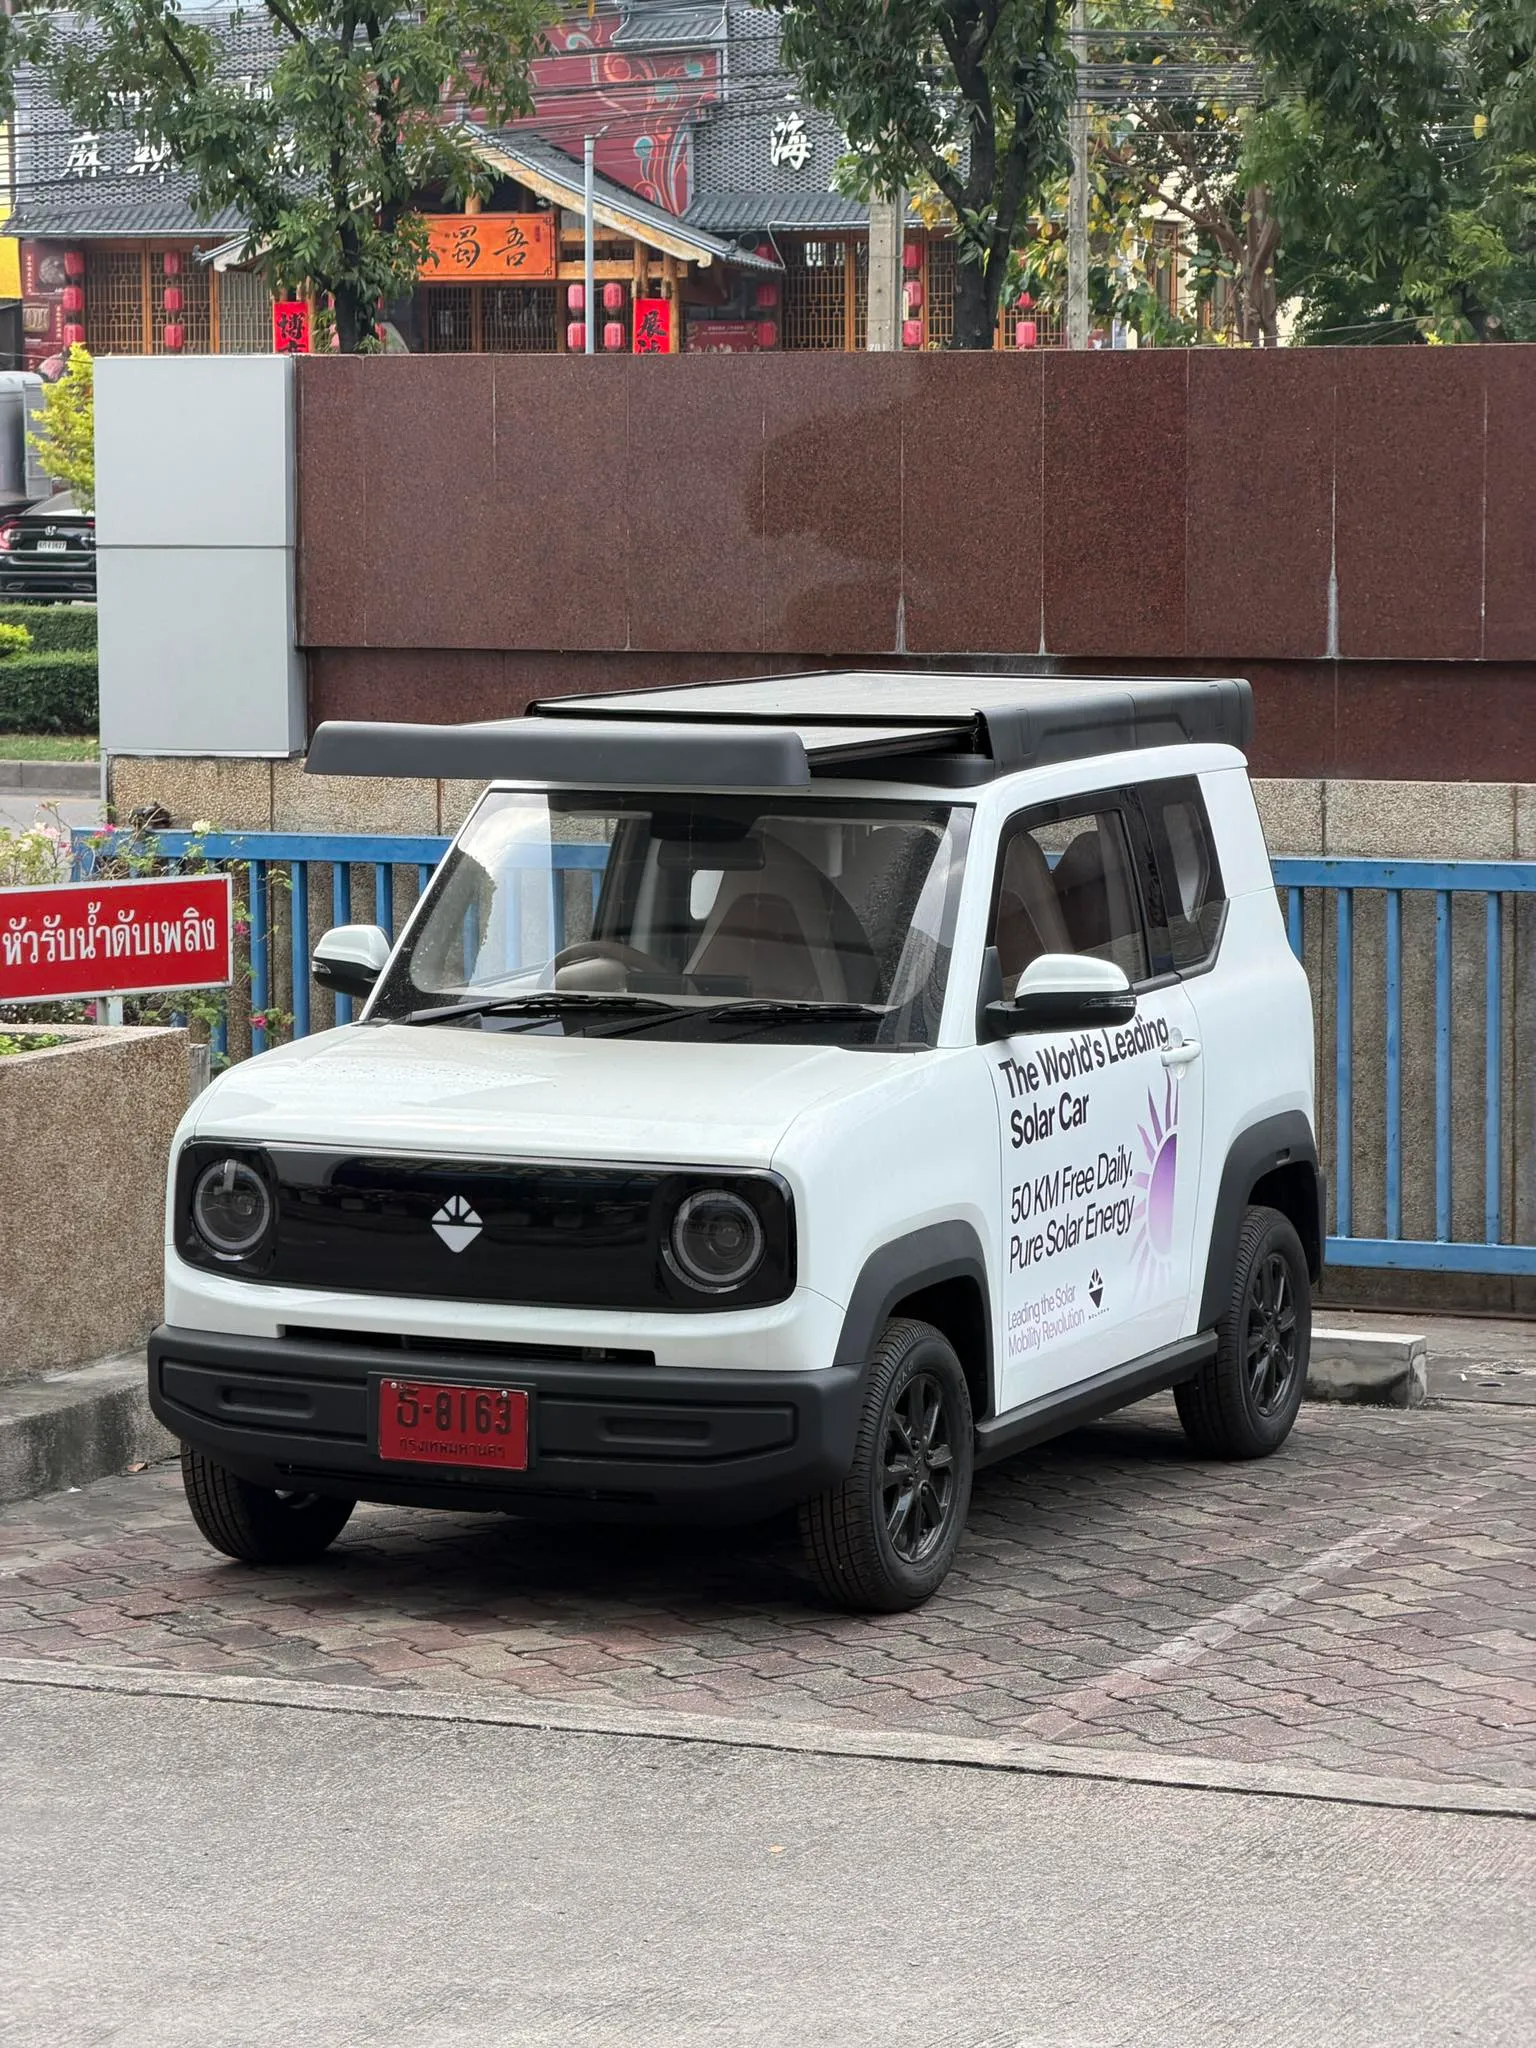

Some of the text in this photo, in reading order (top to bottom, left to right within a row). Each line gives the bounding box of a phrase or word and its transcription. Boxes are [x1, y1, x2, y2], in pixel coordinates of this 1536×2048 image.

[2, 901, 216, 966] หัวรับน้ำดับเพลิง
[998, 1014, 1169, 1098] The World's Leading
[1011, 1091, 1090, 1149] Solar Car
[1011, 1144, 1133, 1225] 50 KM Free Daily.
[1009, 1195, 1135, 1274] Pure Solar Energy
[1007, 1283, 1076, 1331] Leading the Solar
[1008, 1326, 1041, 1358] Mobility
[1041, 1307, 1085, 1343] Revolution
